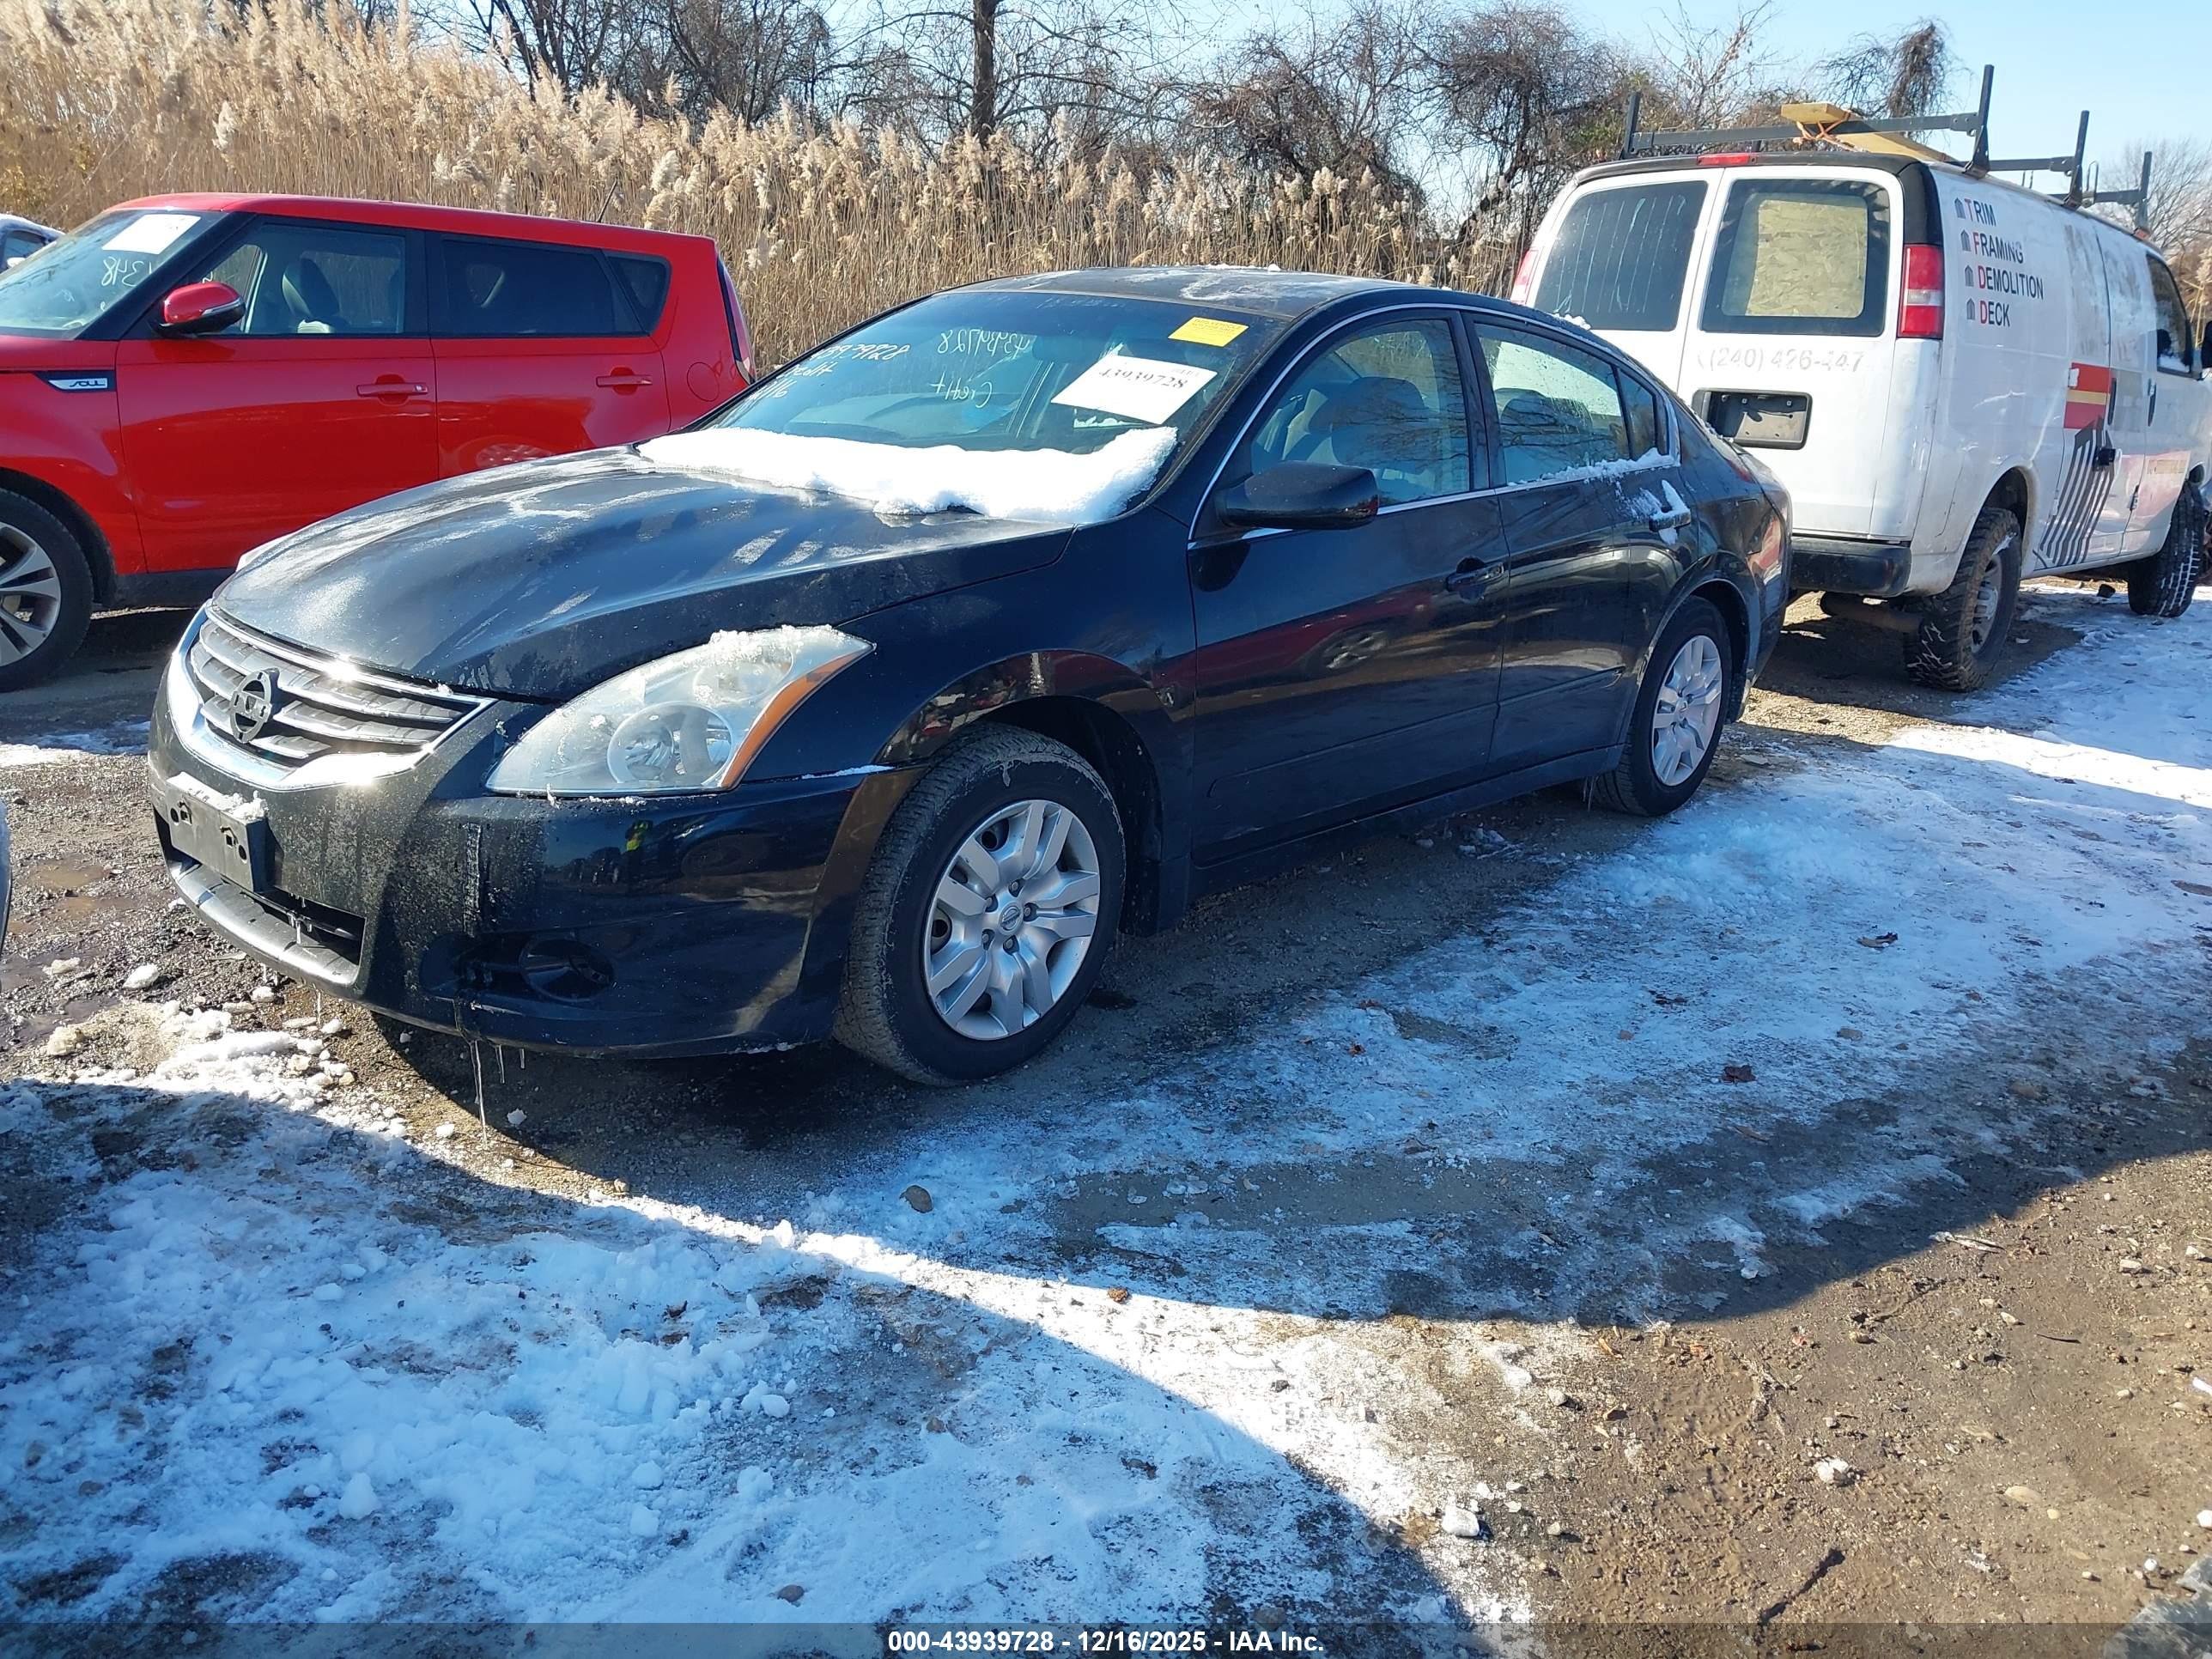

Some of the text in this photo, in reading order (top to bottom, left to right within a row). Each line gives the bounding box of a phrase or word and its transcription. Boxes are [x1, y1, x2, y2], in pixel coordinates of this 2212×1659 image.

[1964, 198, 1996, 227] TRIM
[1972, 232, 2024, 264] FRAMING
[1978, 264, 2044, 300] DEMOLITION
[1979, 301, 2010, 327] DECK
[1710, 347, 1764, 372] (240)
[1098, 368, 1188, 389] 43939728
